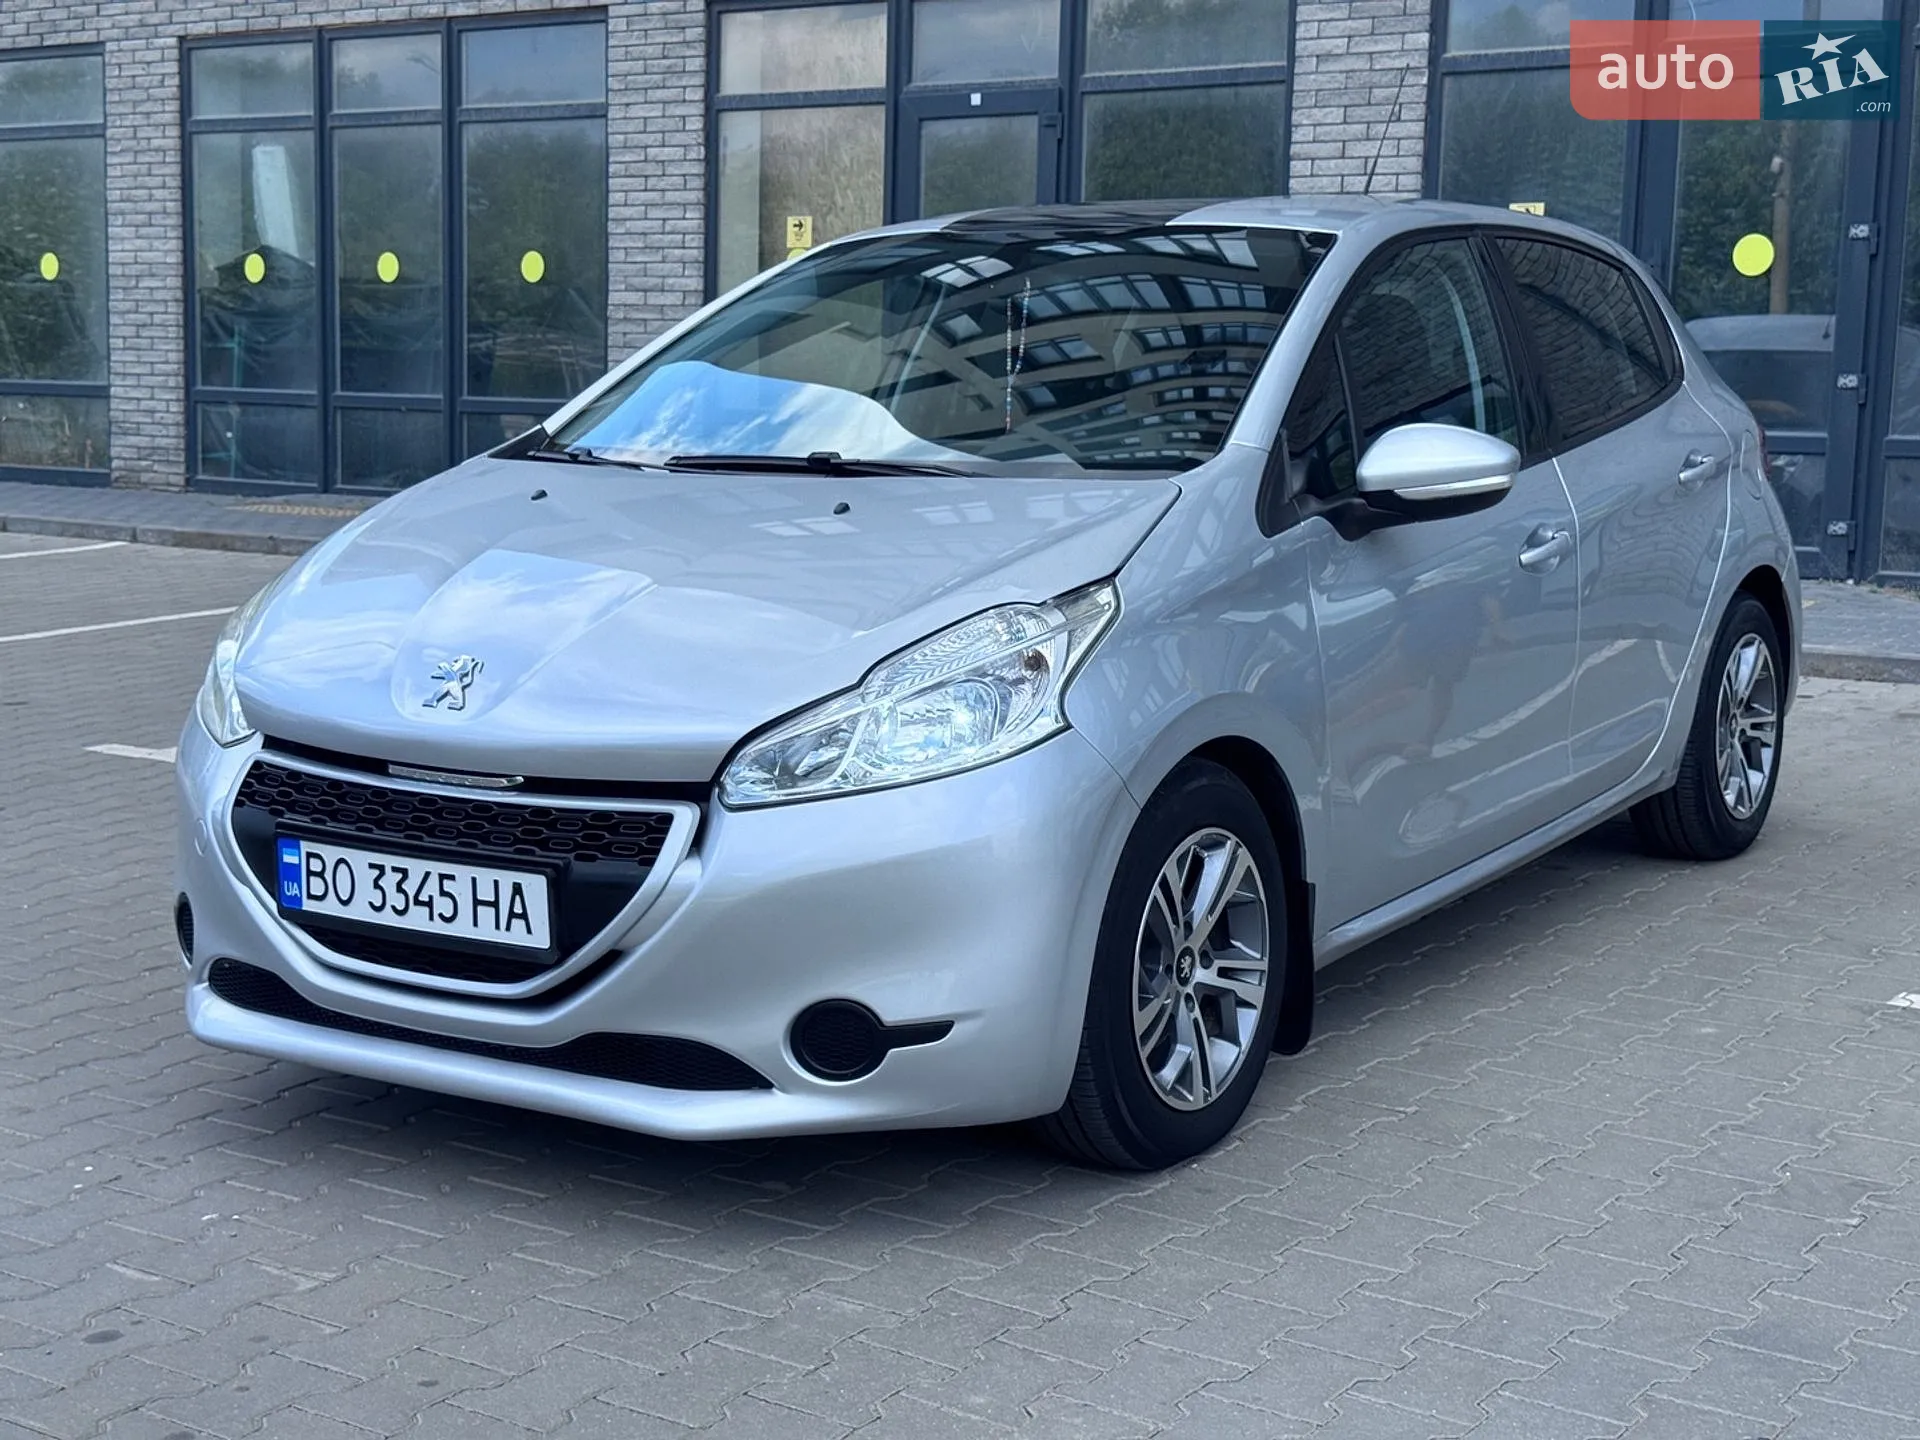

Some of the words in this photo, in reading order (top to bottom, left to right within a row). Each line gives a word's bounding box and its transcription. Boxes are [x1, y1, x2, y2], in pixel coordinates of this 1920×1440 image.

[284, 881, 300, 897] UA
[305, 851, 355, 907] BO
[368, 862, 458, 923] 3345
[471, 876, 533, 935] HA
